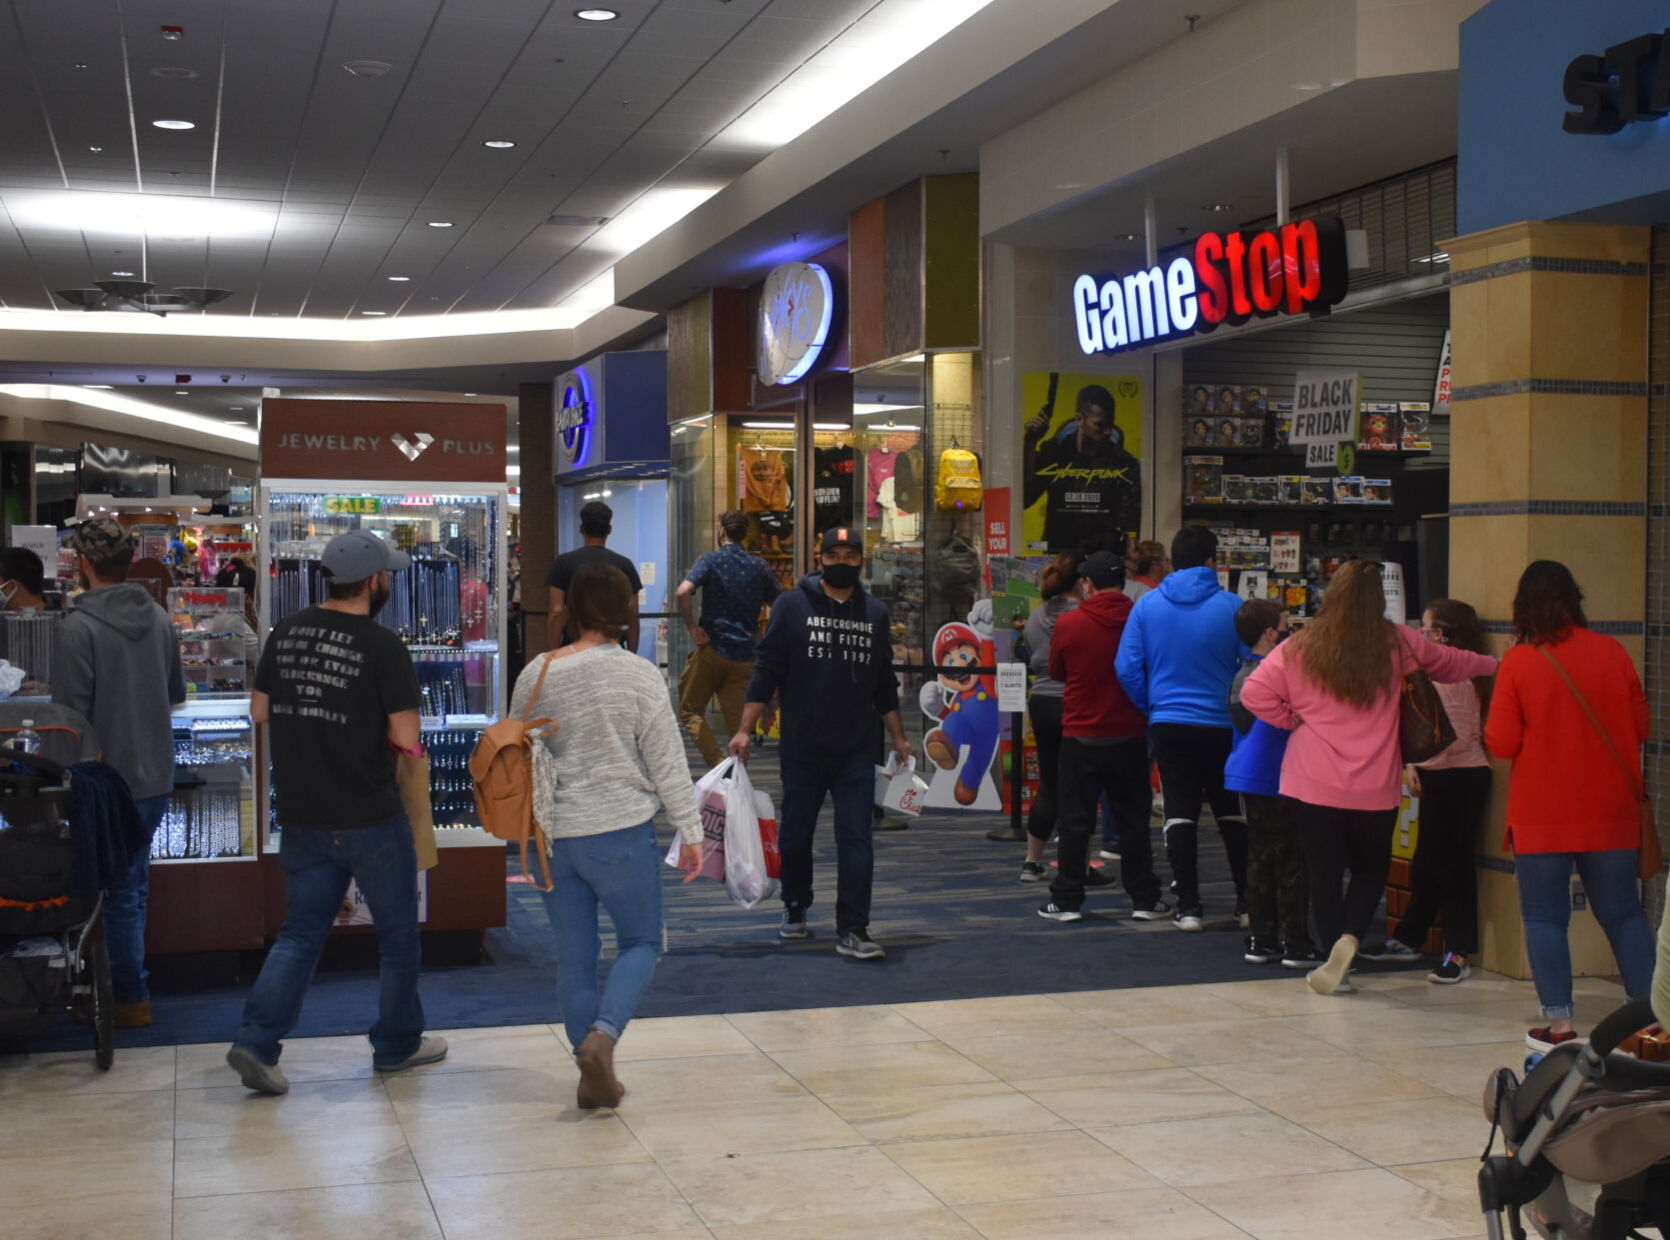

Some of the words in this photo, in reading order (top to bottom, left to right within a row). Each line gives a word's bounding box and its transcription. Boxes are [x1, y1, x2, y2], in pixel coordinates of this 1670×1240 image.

[1563, 27, 1670, 135] ST
[1074, 218, 1321, 355] GameStop
[1298, 379, 1353, 409] BLACK
[1295, 410, 1351, 437] FRIDAY
[278, 433, 382, 450] JEWELRY
[442, 440, 495, 455] PLUS
[1310, 445, 1334, 463] SALE
[326, 499, 376, 514] SALE
[990, 522, 1006, 535] SELL
[806, 615, 873, 634] ABERCROMBIE
[330, 630, 354, 644] LET
[809, 631, 832, 643] AND
[839, 634, 872, 648] FITCH
